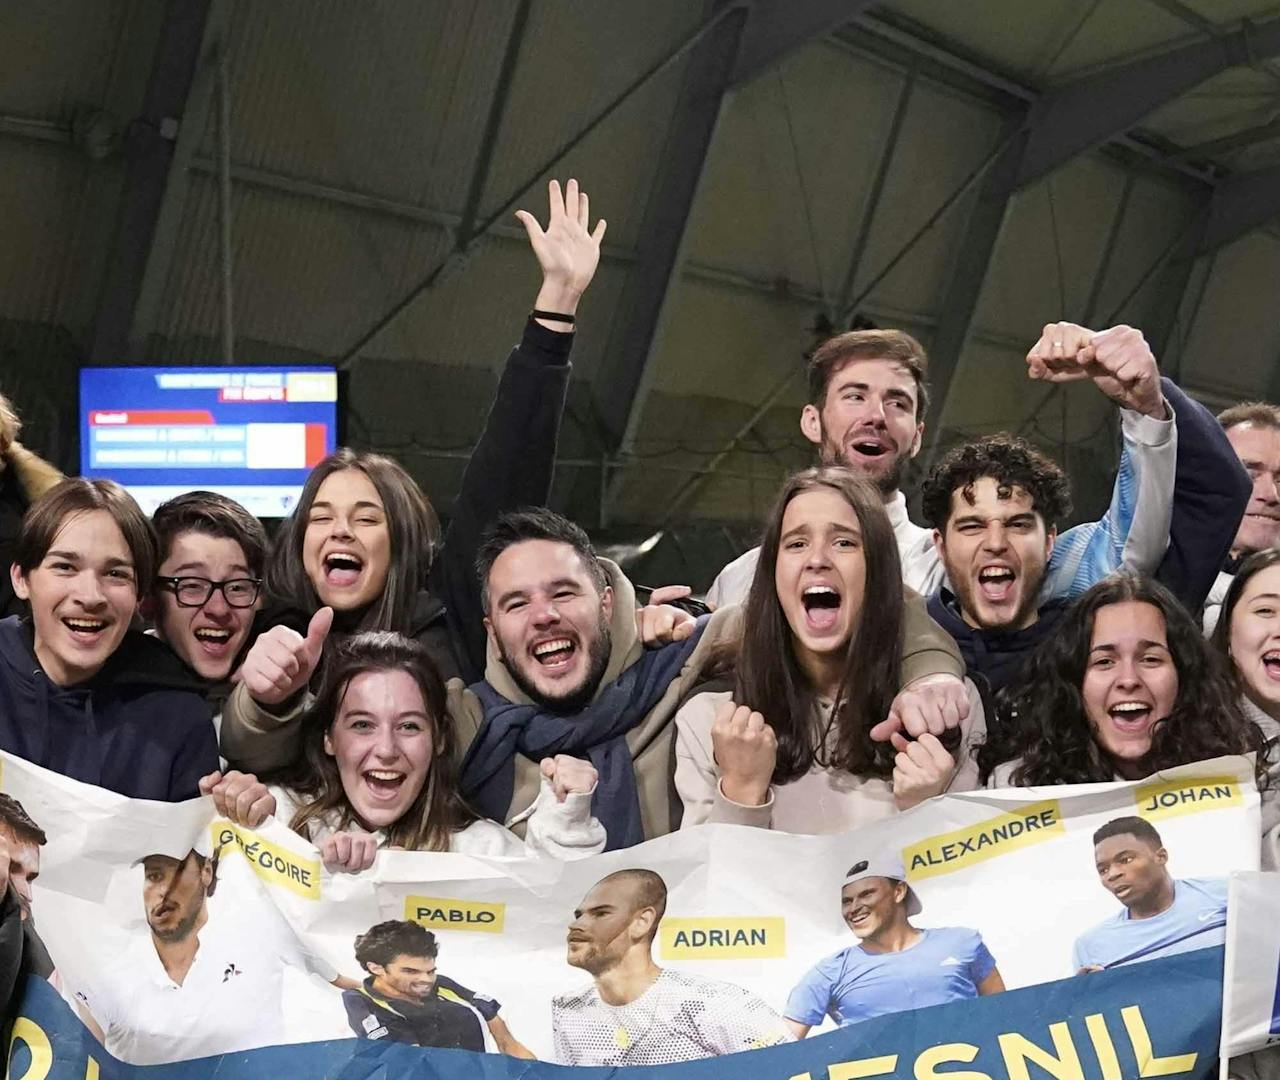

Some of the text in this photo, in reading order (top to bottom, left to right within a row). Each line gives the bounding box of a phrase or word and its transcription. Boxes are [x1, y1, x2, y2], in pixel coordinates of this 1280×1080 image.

[1145, 785, 1233, 812] JOHAN
[910, 808, 1058, 871] ALEXANDRE
[416, 906, 496, 924] PABLO
[673, 926, 767, 949] ADRIAN
